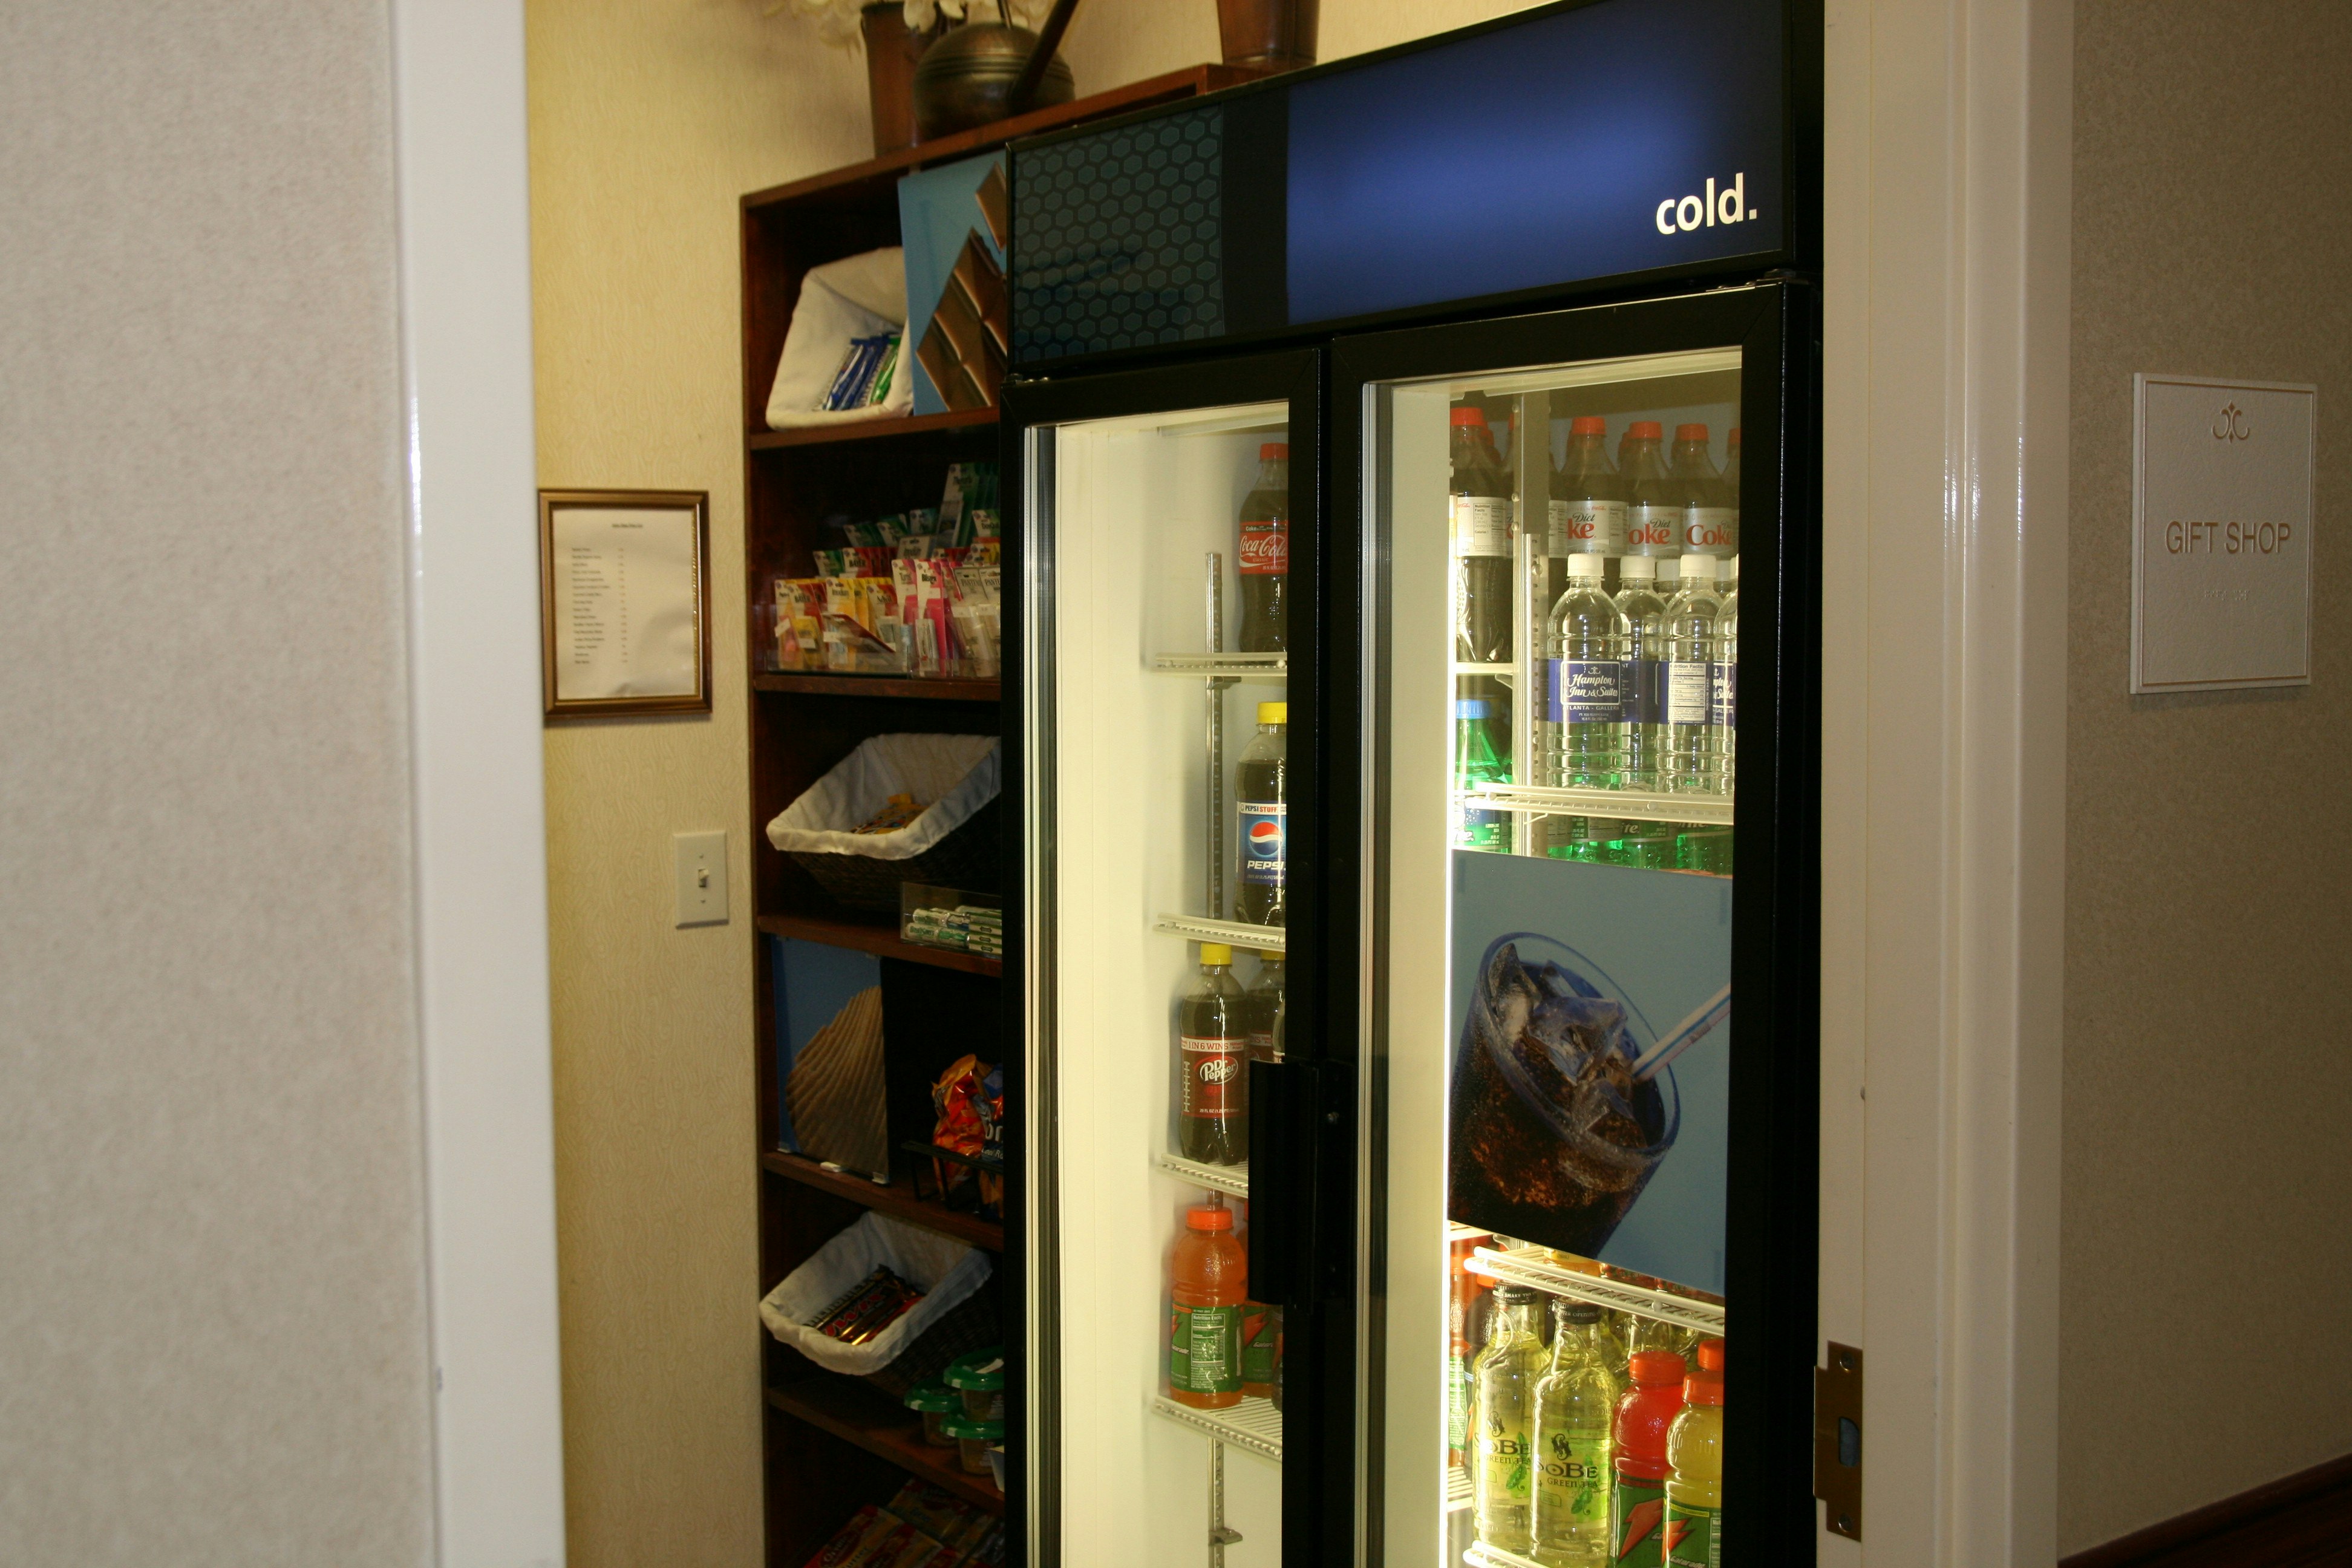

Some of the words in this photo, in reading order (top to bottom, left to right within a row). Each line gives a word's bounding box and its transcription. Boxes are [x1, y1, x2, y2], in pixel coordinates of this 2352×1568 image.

[1656, 172, 1757, 235] cold.
[1573, 512, 1596, 522] Diet
[1650, 518, 1671, 528] Diet
[1567, 518, 1595, 540] ke
[1628, 523, 1671, 545] oke
[1685, 524, 1733, 546] Coke
[2165, 521, 2219, 554] GIFT
[2224, 521, 2292, 554] SHOP
[1240, 535, 1287, 557] Coca-Cola
[1567, 673, 1615, 687] Hampton
[1565, 687, 1590, 697] Inn
[1596, 686, 1618, 697] Suites
[1247, 860, 1285, 871] PEPSI
[1214, 1059, 1229, 1070] Dr
[1200, 1062, 1236, 1082] Pepper
[1547, 1477, 1578, 1488] GREEN
[1582, 1479, 1598, 1488] TEA
[1670, 1555, 1707, 1568] Gatorade
